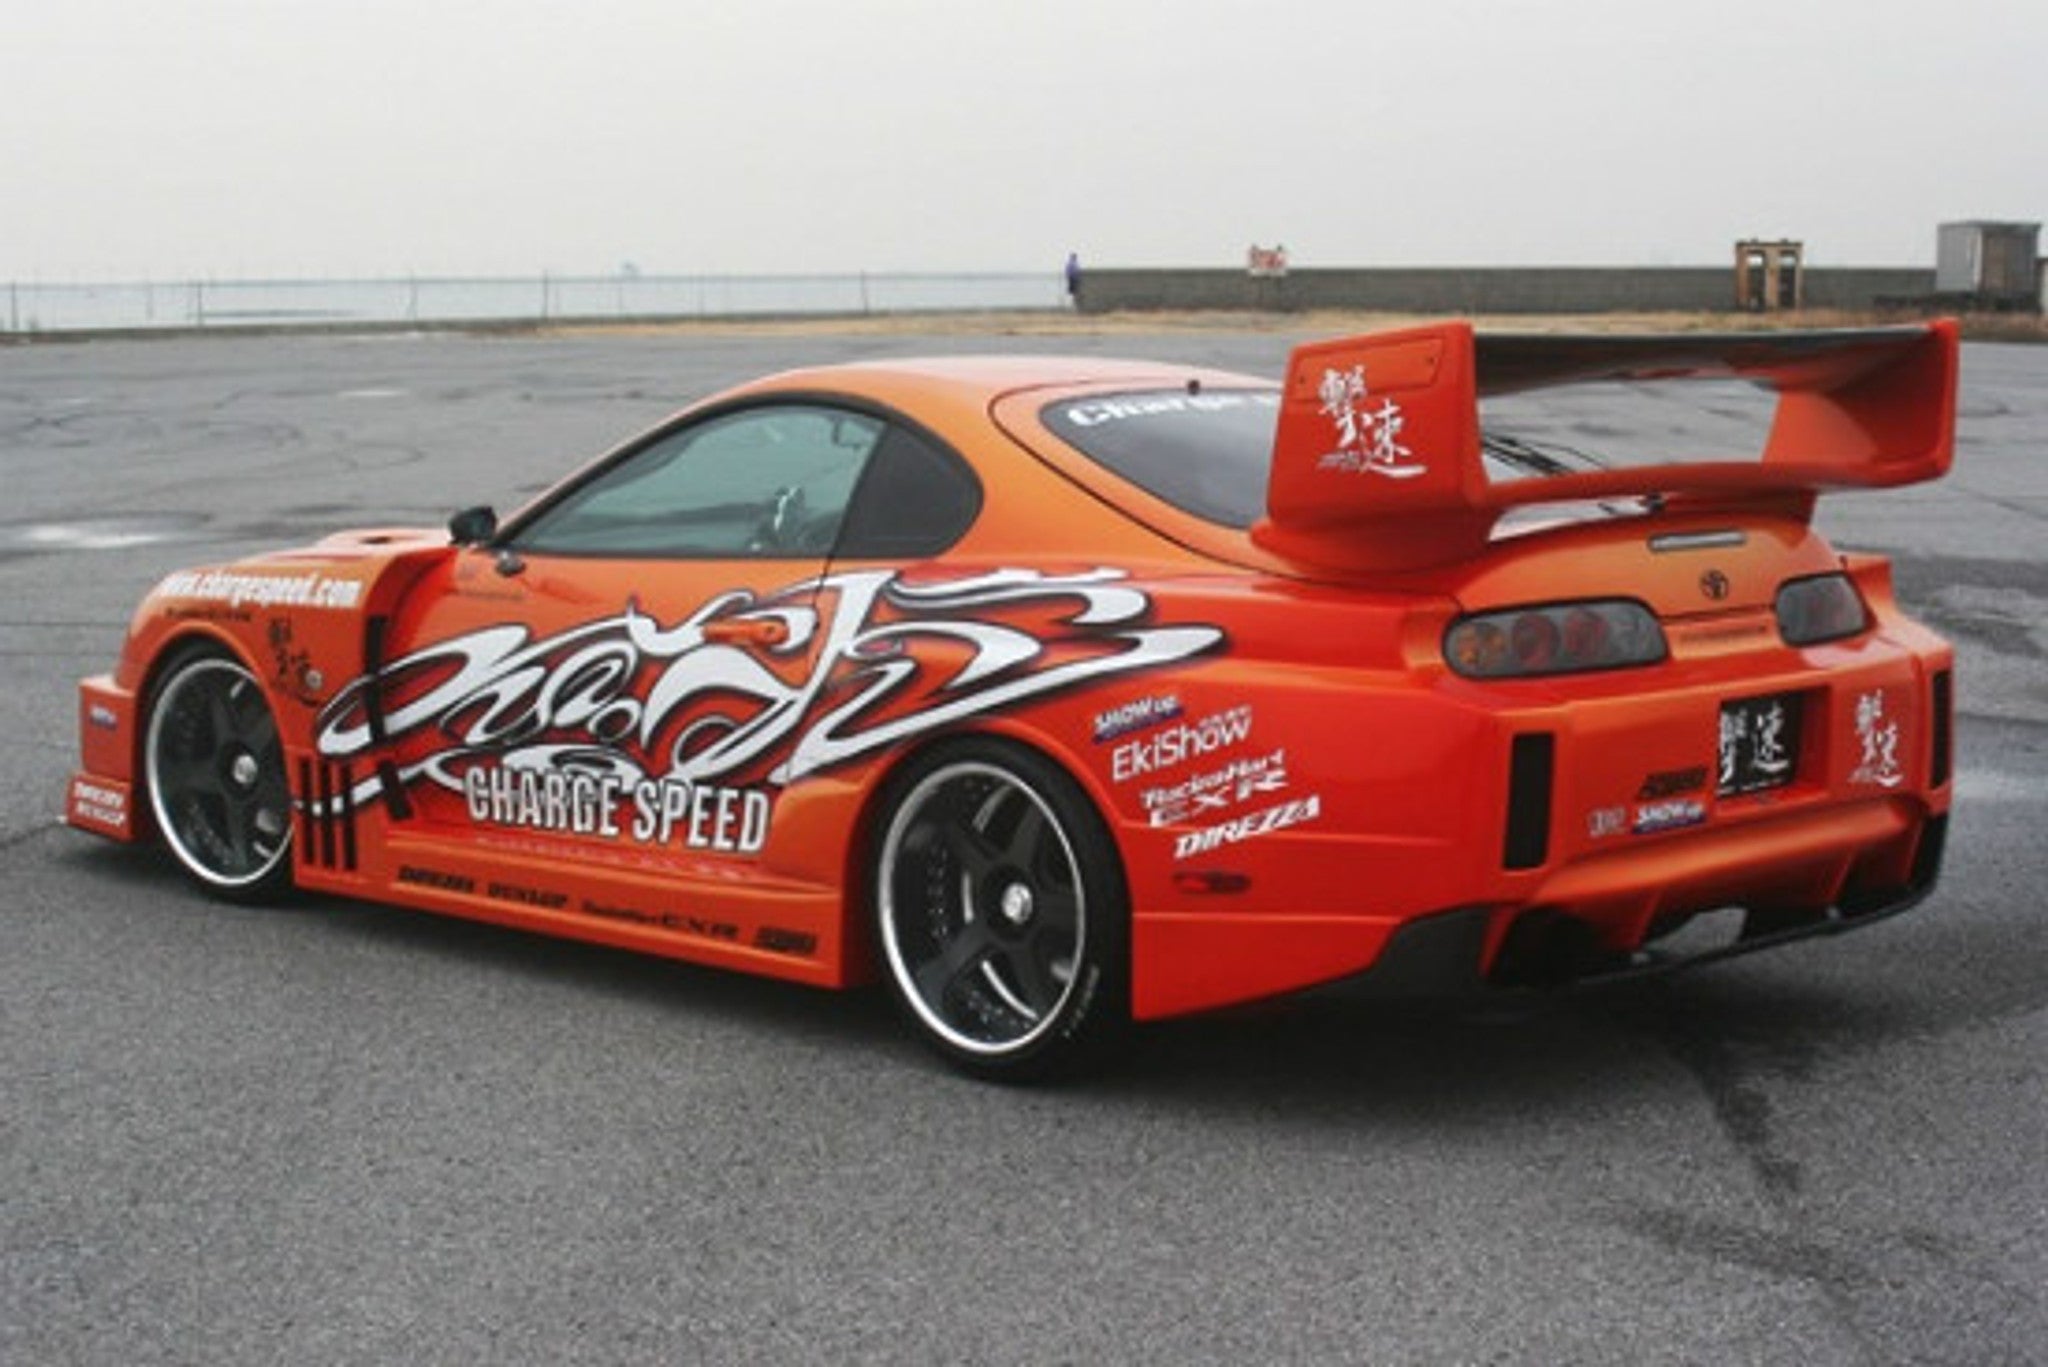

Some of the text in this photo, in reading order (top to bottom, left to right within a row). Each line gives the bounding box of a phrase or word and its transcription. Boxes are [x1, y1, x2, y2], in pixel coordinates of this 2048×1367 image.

[1094, 694, 1152, 735] SHOW
[1112, 711, 1252, 782] EkiShow
[466, 766, 770, 853] CHARGE SPEED
[1173, 795, 1321, 860] DIREZZA
